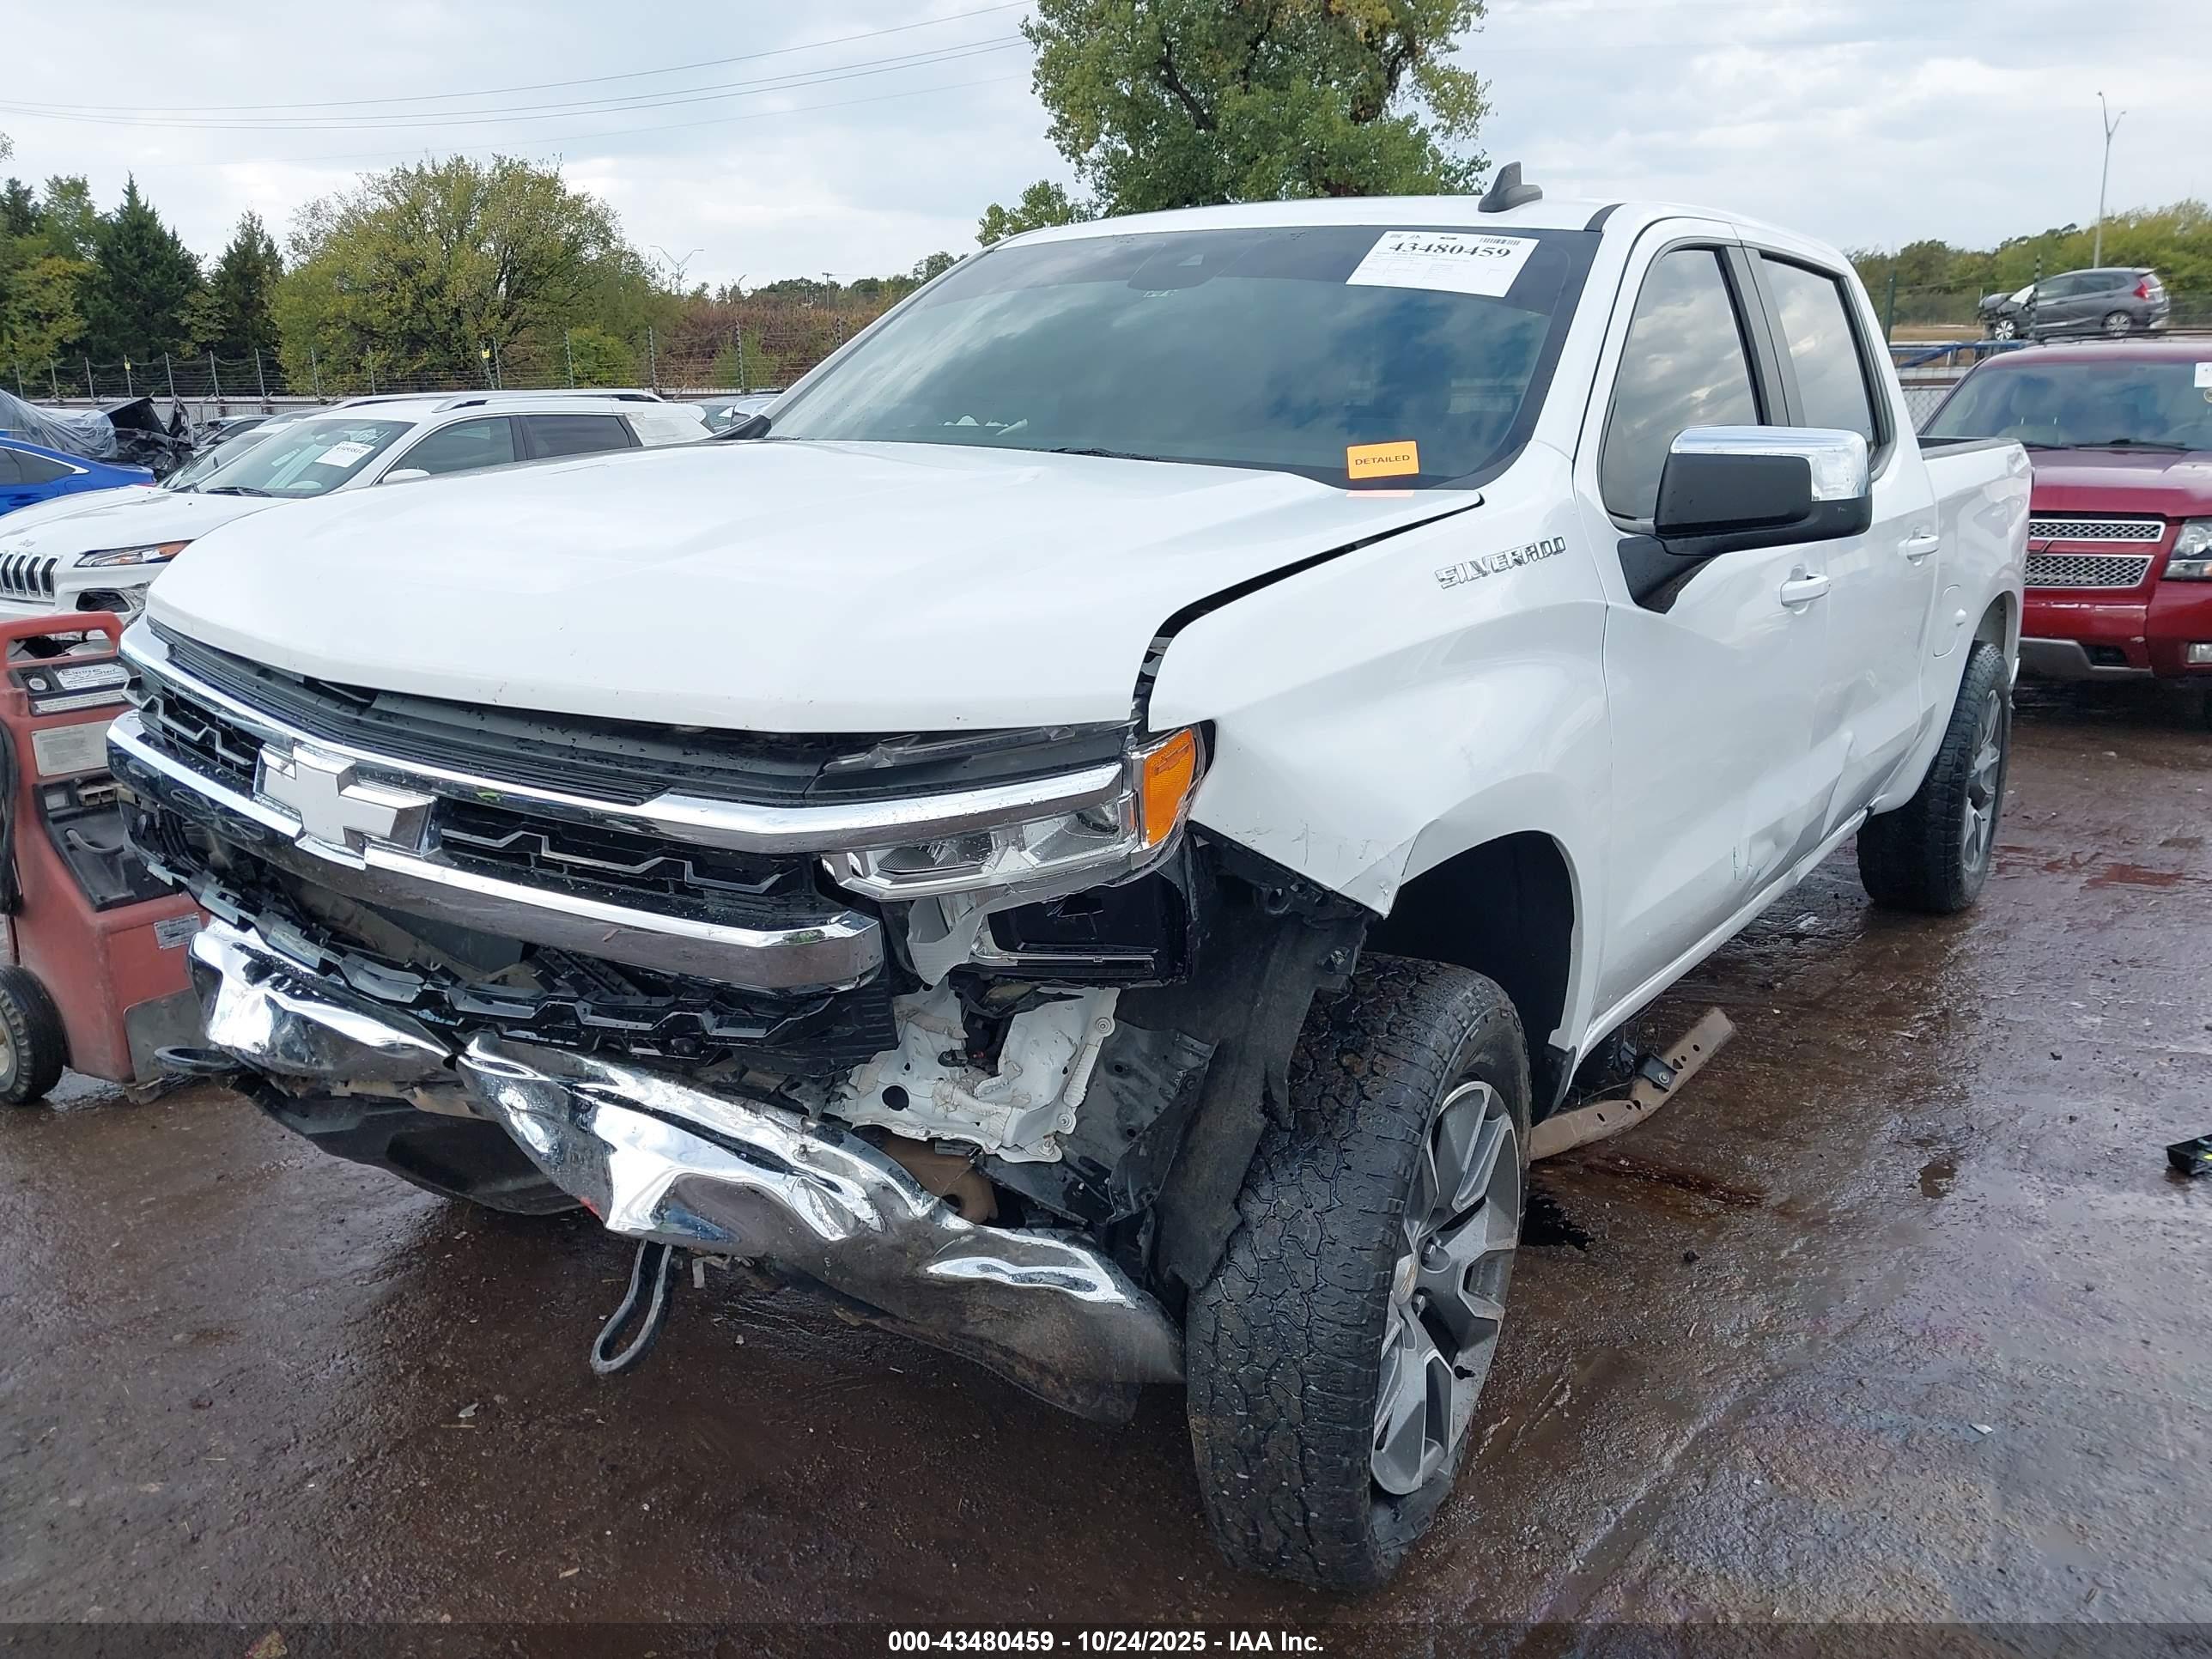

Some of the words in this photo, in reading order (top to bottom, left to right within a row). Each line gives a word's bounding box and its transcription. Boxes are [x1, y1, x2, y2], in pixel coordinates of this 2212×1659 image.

[1389, 241, 1511, 258] 43480459
[1354, 454, 1411, 465] DETAILED
[1434, 536, 1567, 590] SILVERADO
